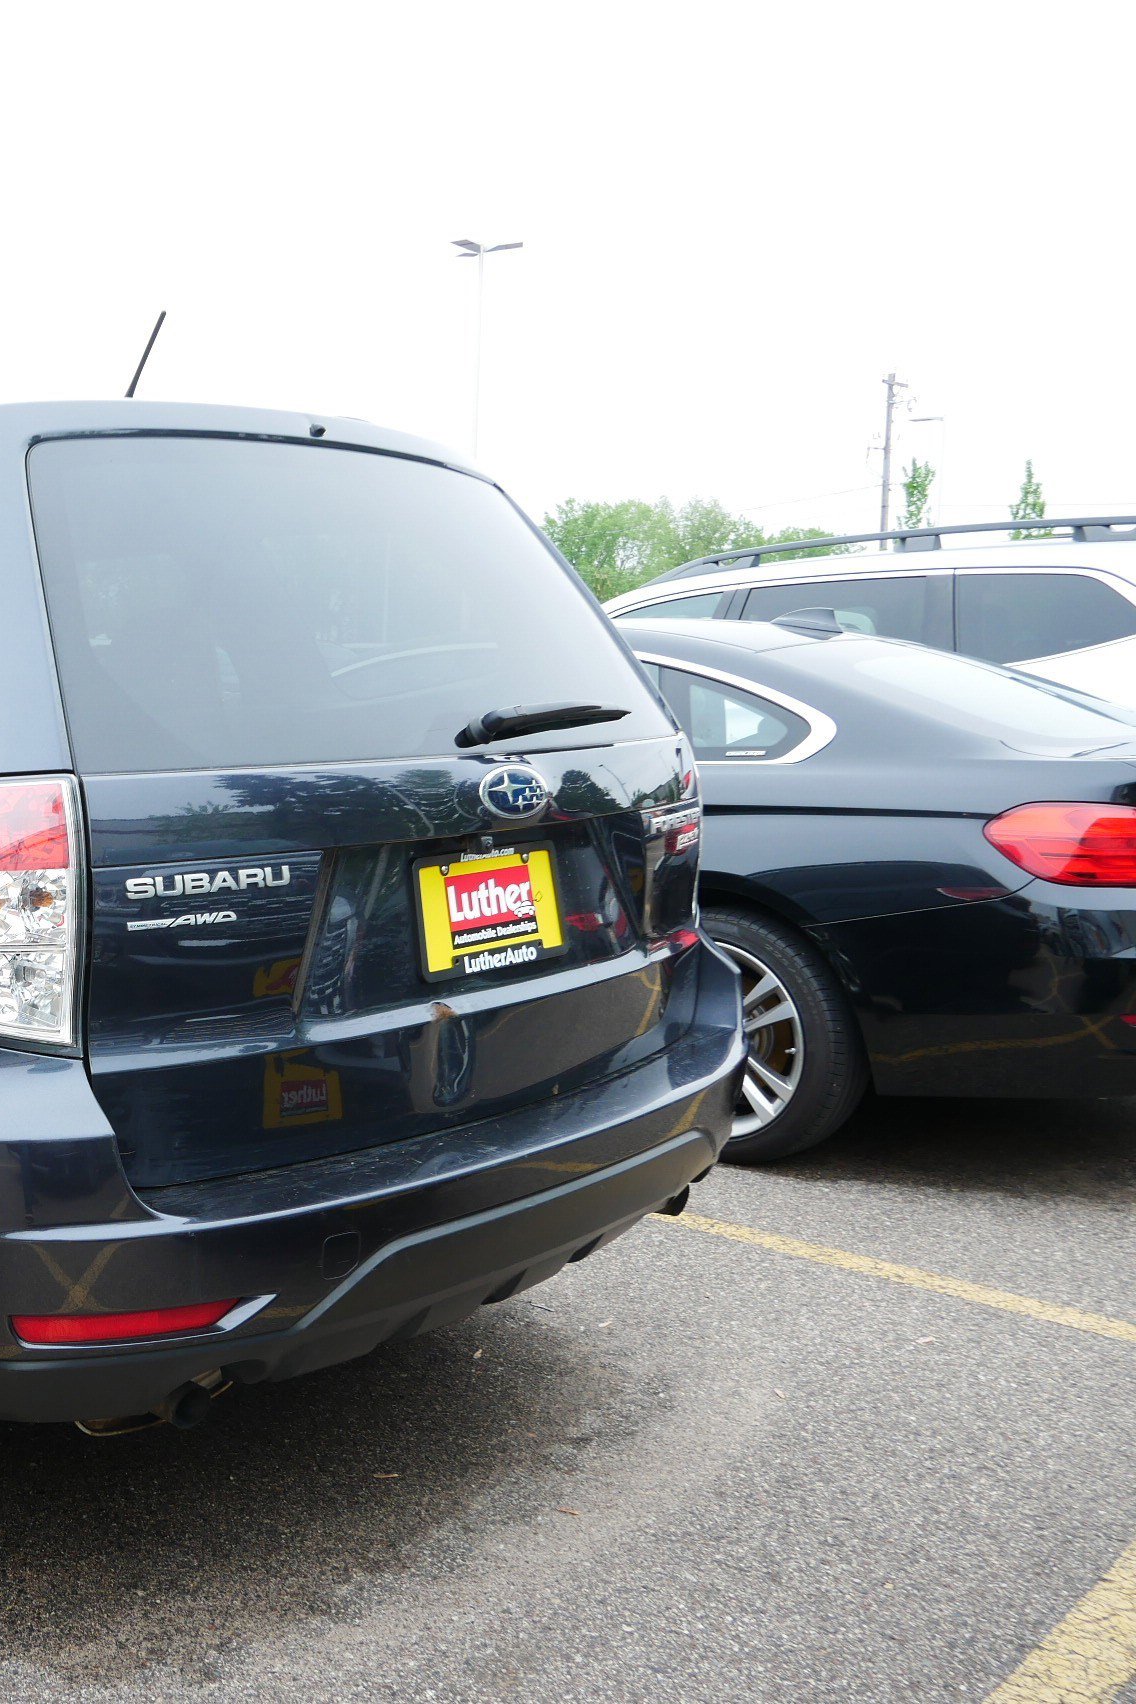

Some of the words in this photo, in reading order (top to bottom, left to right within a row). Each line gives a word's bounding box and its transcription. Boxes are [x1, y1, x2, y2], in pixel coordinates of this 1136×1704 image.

[125, 865, 291, 900] SUBARU
[446, 878, 531, 923] Luther
[169, 911, 238, 928] AWD
[454, 928, 497, 945] Automobile
[497, 920, 537, 937] Dealerships
[464, 945, 538, 974] LutherAuto
